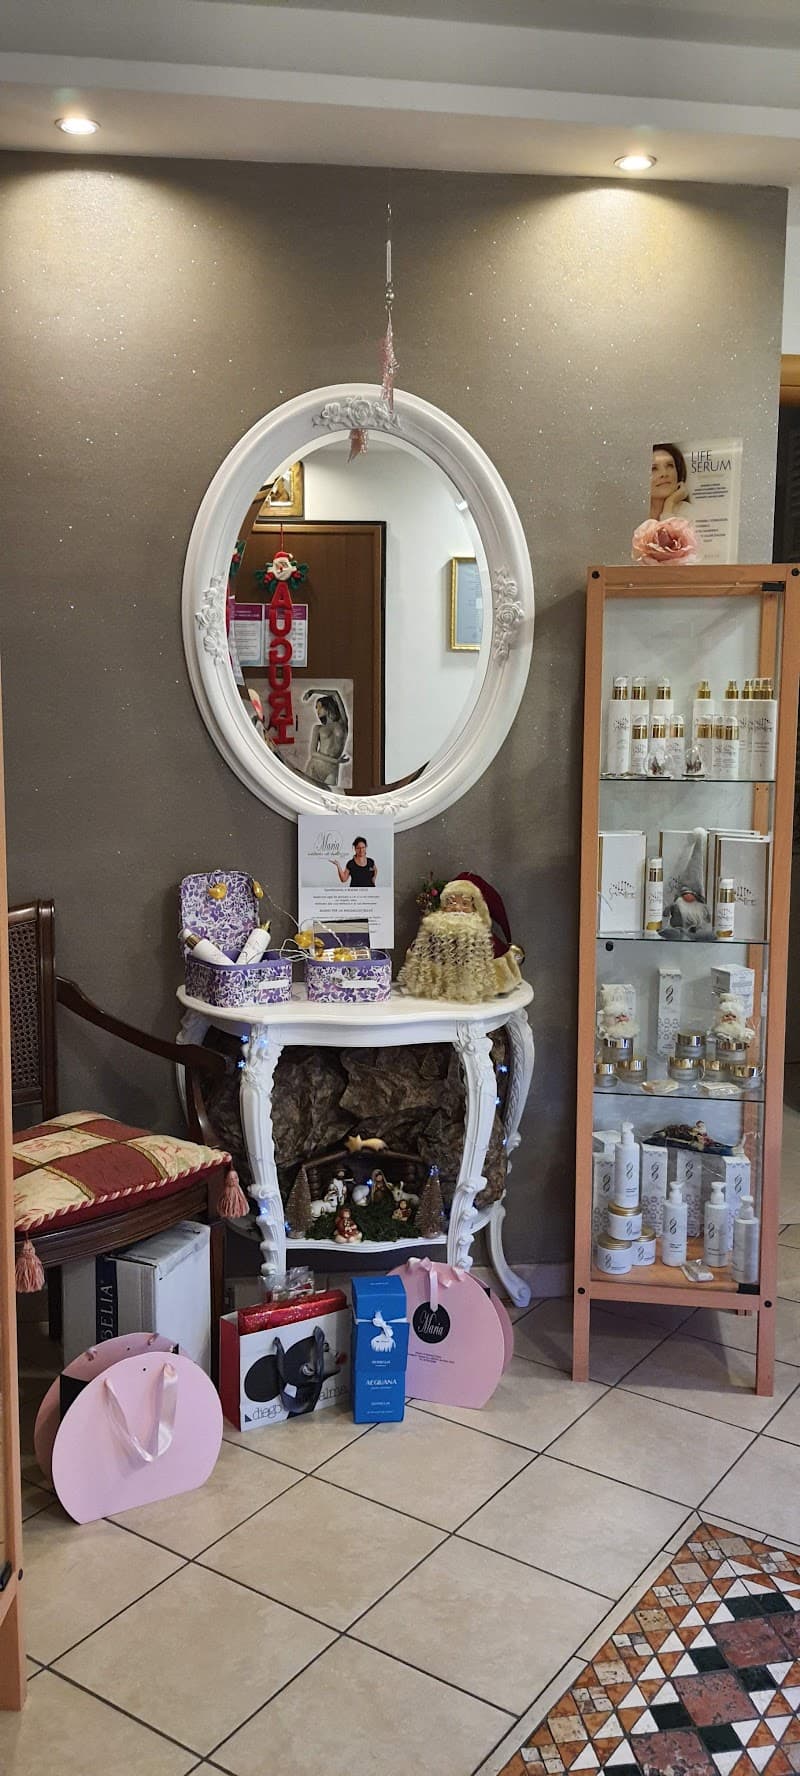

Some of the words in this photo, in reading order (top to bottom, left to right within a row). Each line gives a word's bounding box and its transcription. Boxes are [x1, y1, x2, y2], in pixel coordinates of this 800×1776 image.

[691, 450, 712, 462] LIFE
[691, 460, 732, 473] SERUM
[417, 1310, 444, 1336] Maria
[252, 1405, 282, 1420] diego
